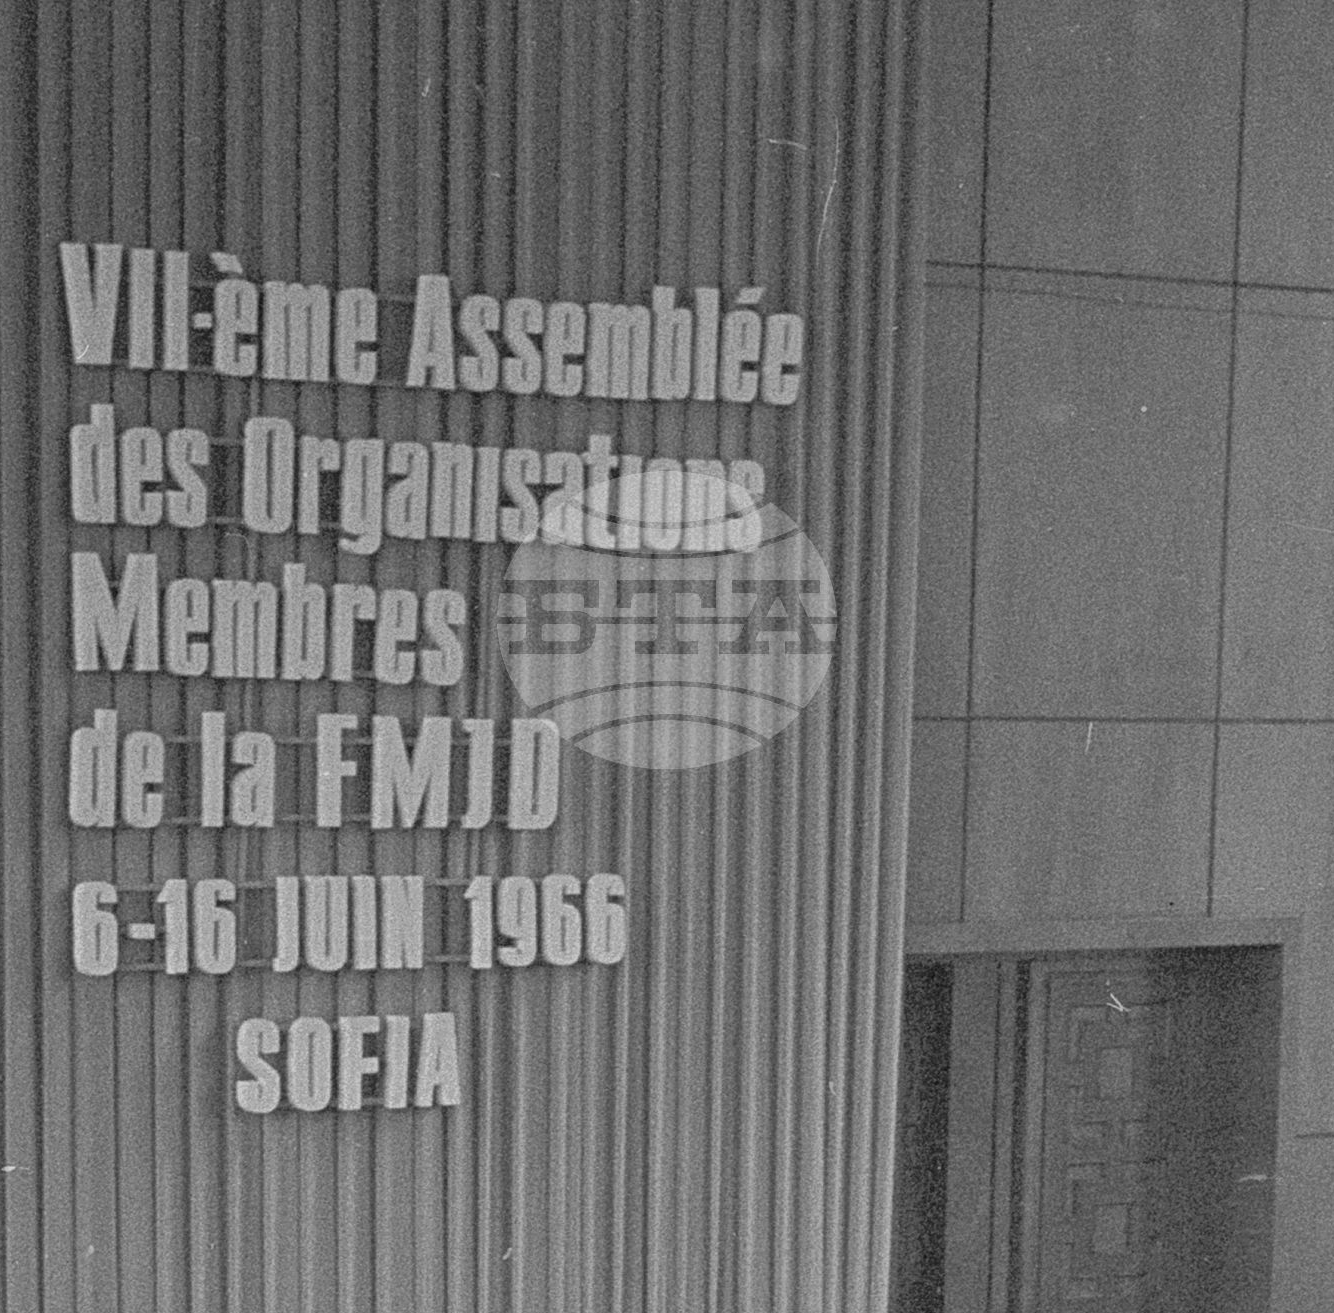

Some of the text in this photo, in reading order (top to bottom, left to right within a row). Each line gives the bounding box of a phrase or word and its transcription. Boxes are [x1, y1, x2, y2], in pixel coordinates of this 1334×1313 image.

[60, 243, 805, 405] VII-ème Assemblée
[70, 404, 765, 556] des Organisations
[72, 552, 466, 687] Membres
[69, 708, 560, 830] de la FMJD
[72, 874, 627, 976] 6-16 JUIN 1966
[235, 1012, 461, 1114] SOFIA
